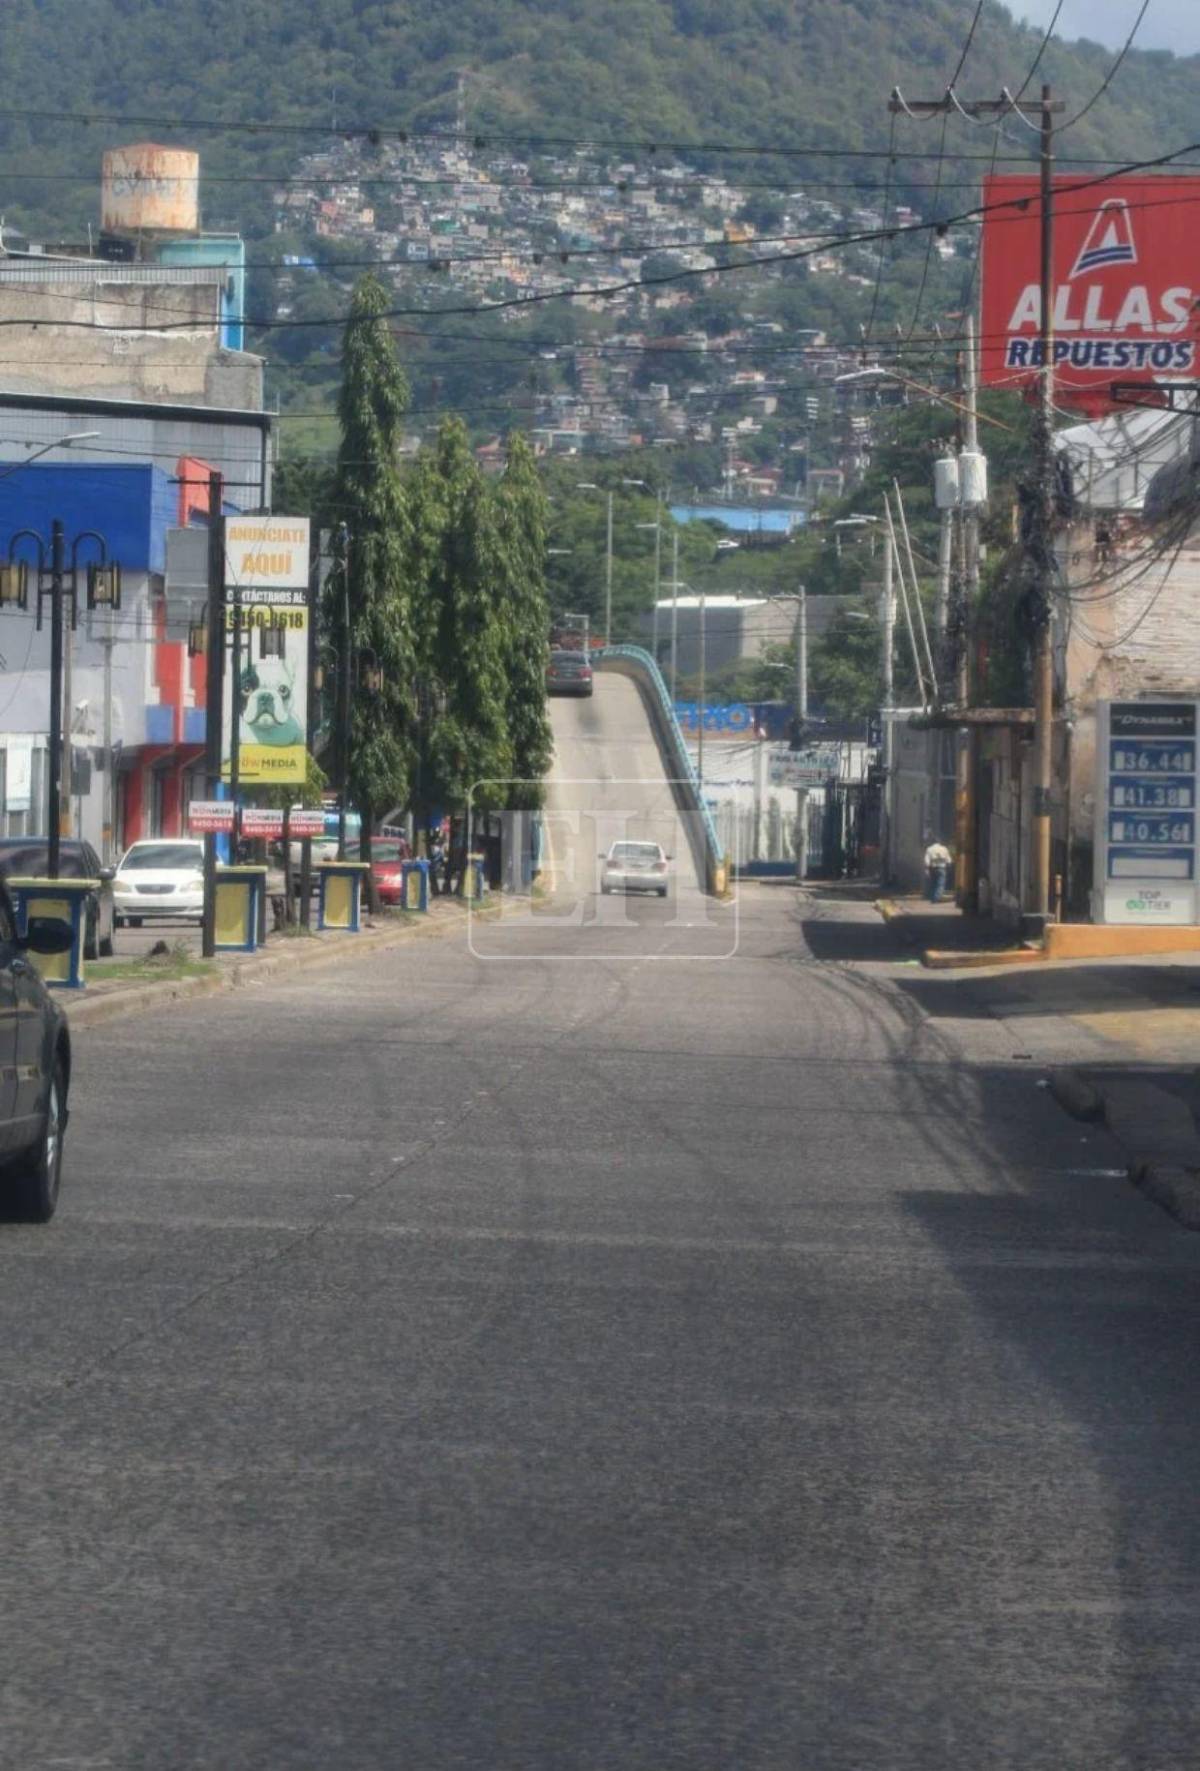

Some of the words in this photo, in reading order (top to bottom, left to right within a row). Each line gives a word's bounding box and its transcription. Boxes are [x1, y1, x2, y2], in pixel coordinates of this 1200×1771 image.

[1007, 284, 1192, 334] ALLAS
[1005, 337, 1195, 369] REPUESTOS
[228, 526, 306, 543] ANUNCIATE
[226, 588, 291, 603] CNTÁCTANOS
[1126, 751, 1183, 770] 36.44
[1126, 787, 1177, 806] 41.38
